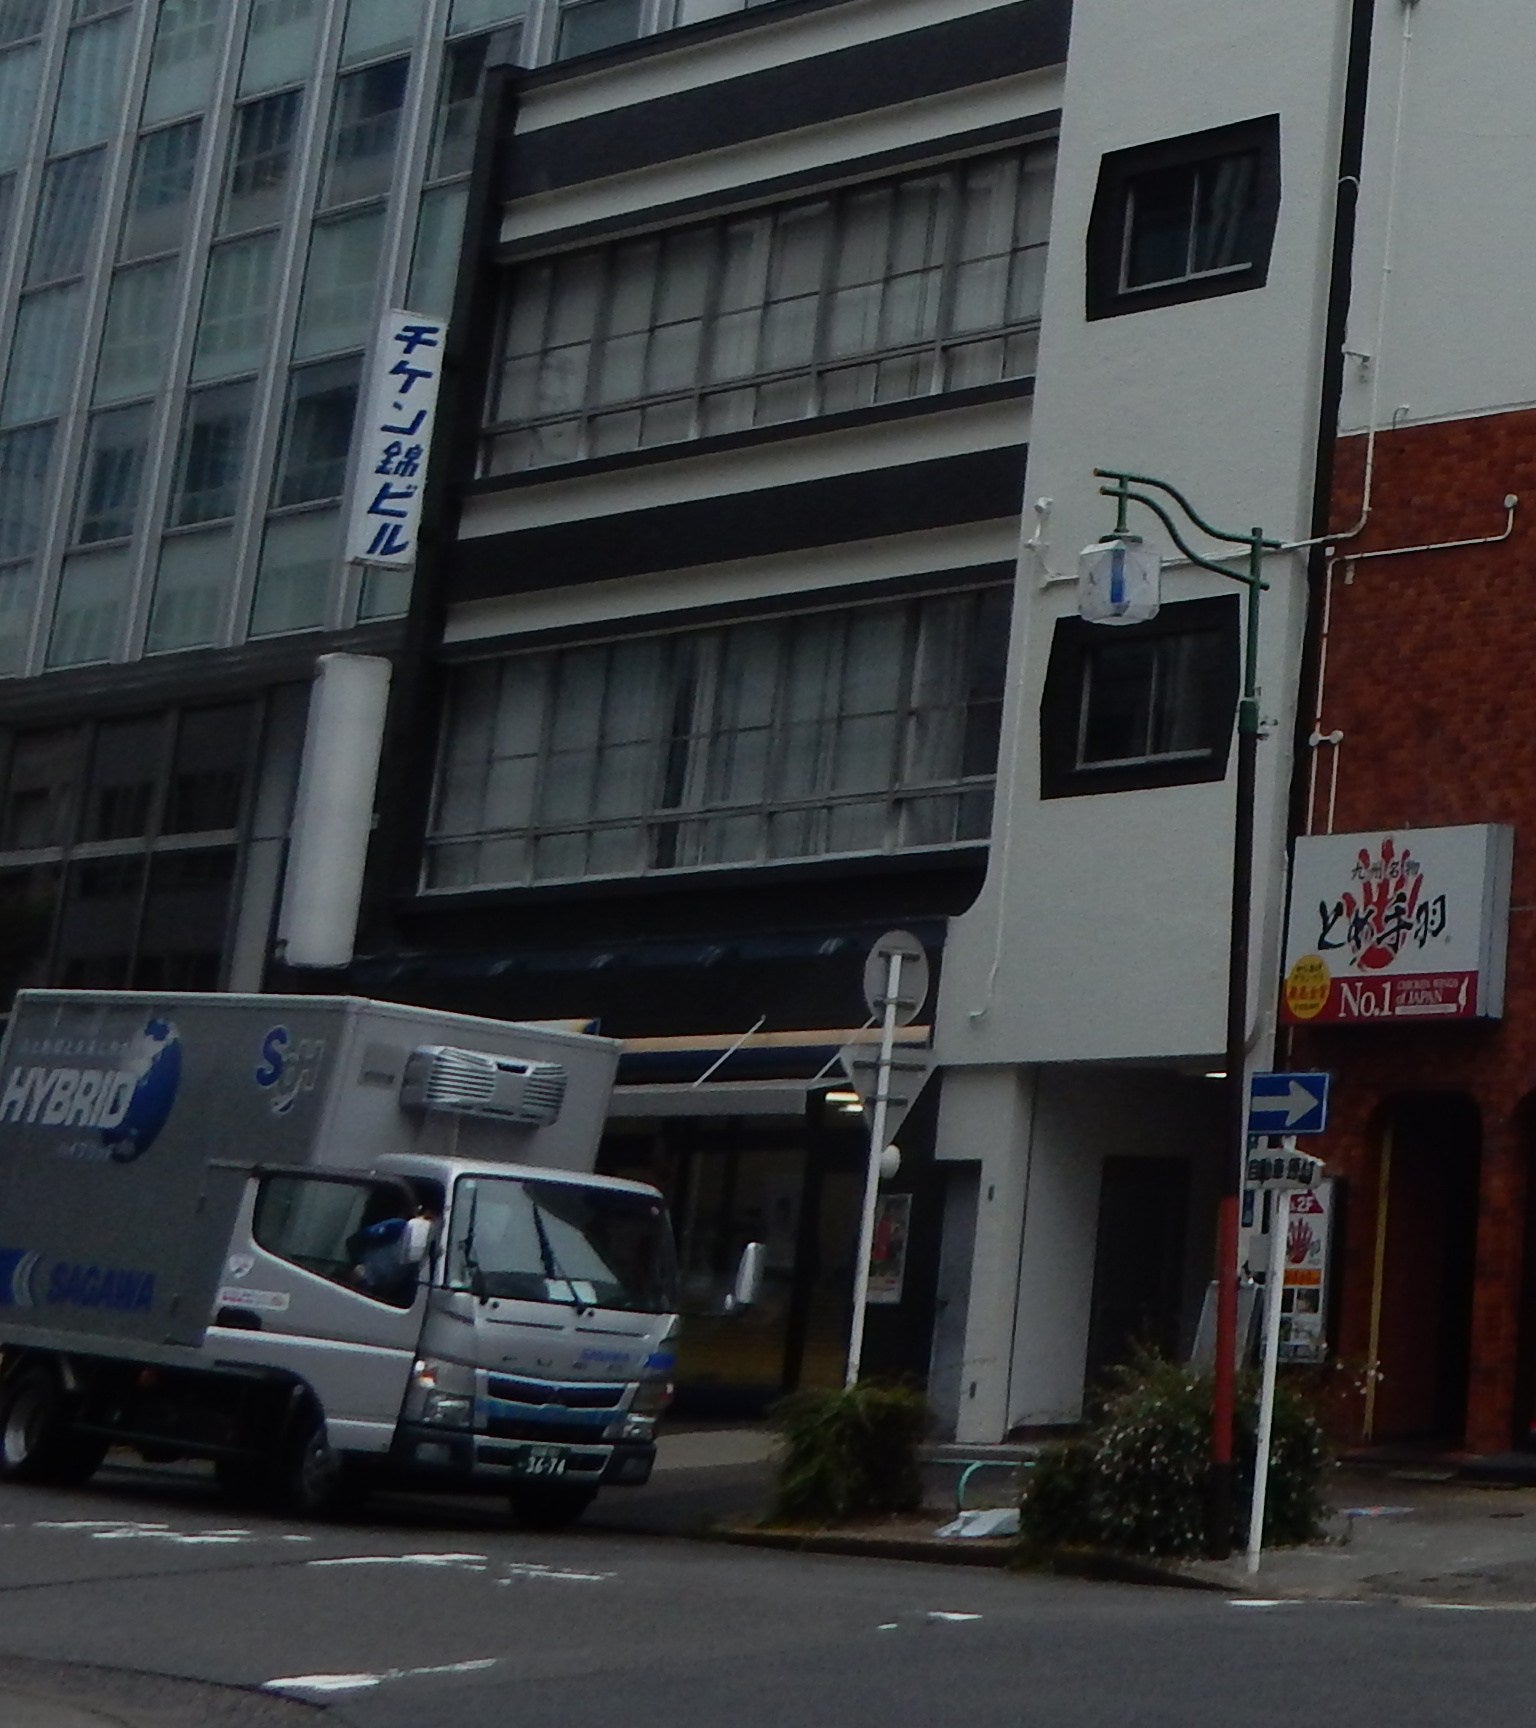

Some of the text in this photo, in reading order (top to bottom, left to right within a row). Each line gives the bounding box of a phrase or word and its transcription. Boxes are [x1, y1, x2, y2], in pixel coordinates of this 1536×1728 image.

[367, 325, 440, 557] チケン錦ビル
[1352, 860, 1421, 881] 九州名物
[1317, 892, 1447, 967] とめ手羽
[1338, 980, 1393, 1018] No.1
[1408, 990, 1443, 1005] JAPAN
[0, 1066, 138, 1129] HYBRID
[48, 1260, 155, 1313] SAGAWA
